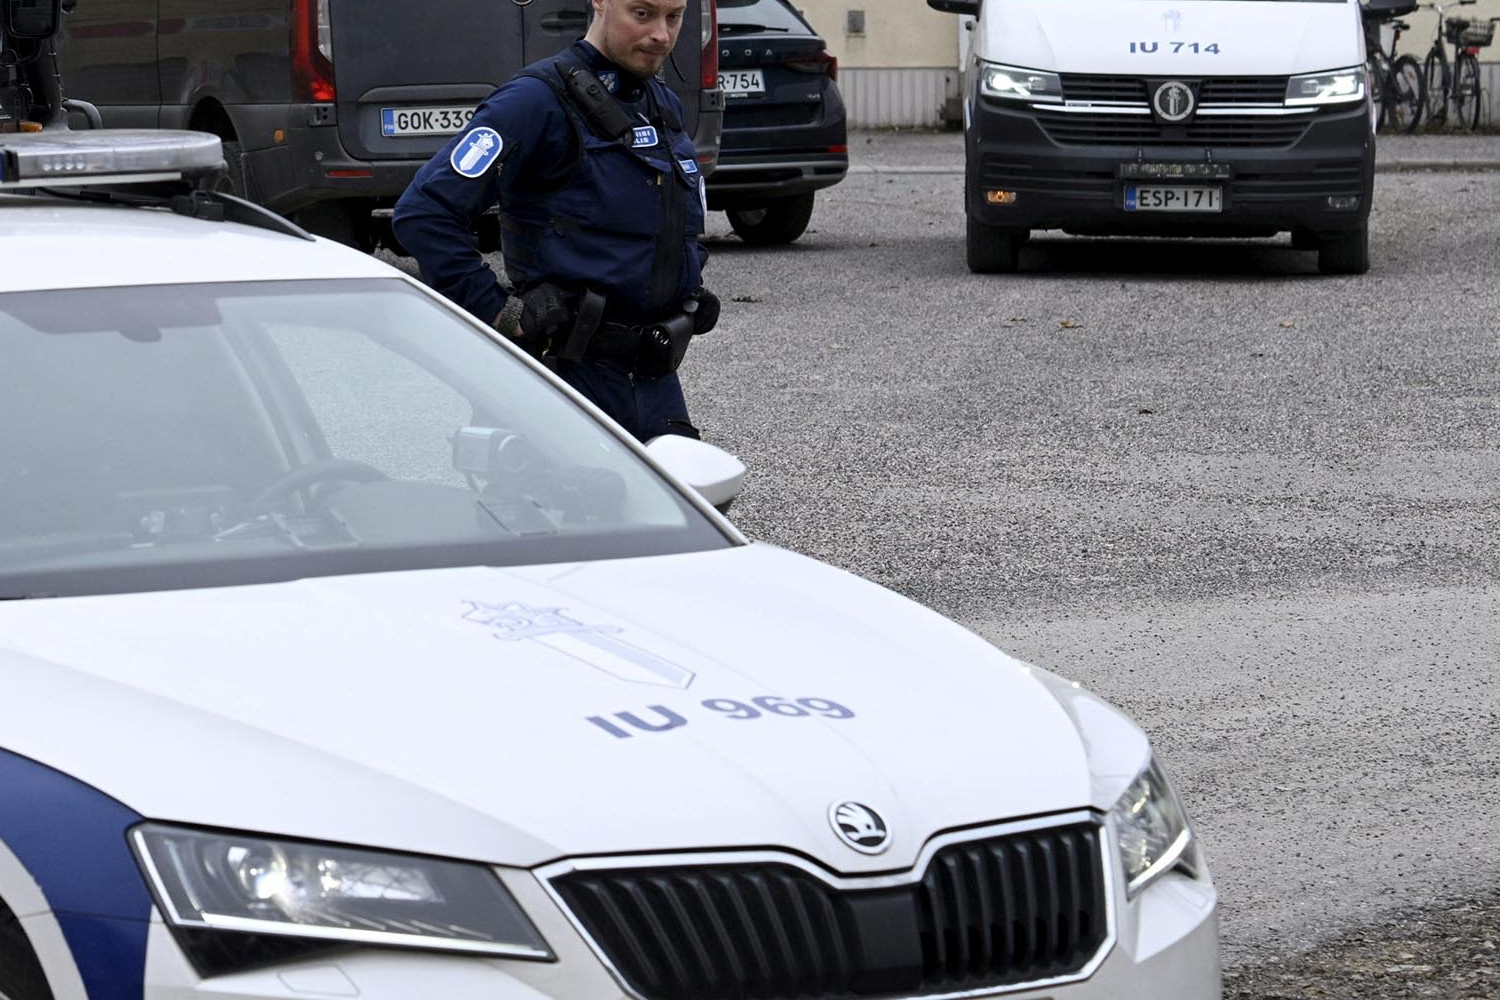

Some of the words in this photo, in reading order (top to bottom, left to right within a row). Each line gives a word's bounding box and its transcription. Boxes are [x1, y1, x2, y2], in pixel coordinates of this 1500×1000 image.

[1129, 42, 1159, 54] IU
[1169, 42, 1221, 55] 714
[1139, 189, 1213, 208] ESP-171
[584, 704, 688, 739] IU
[700, 695, 856, 720] 969
